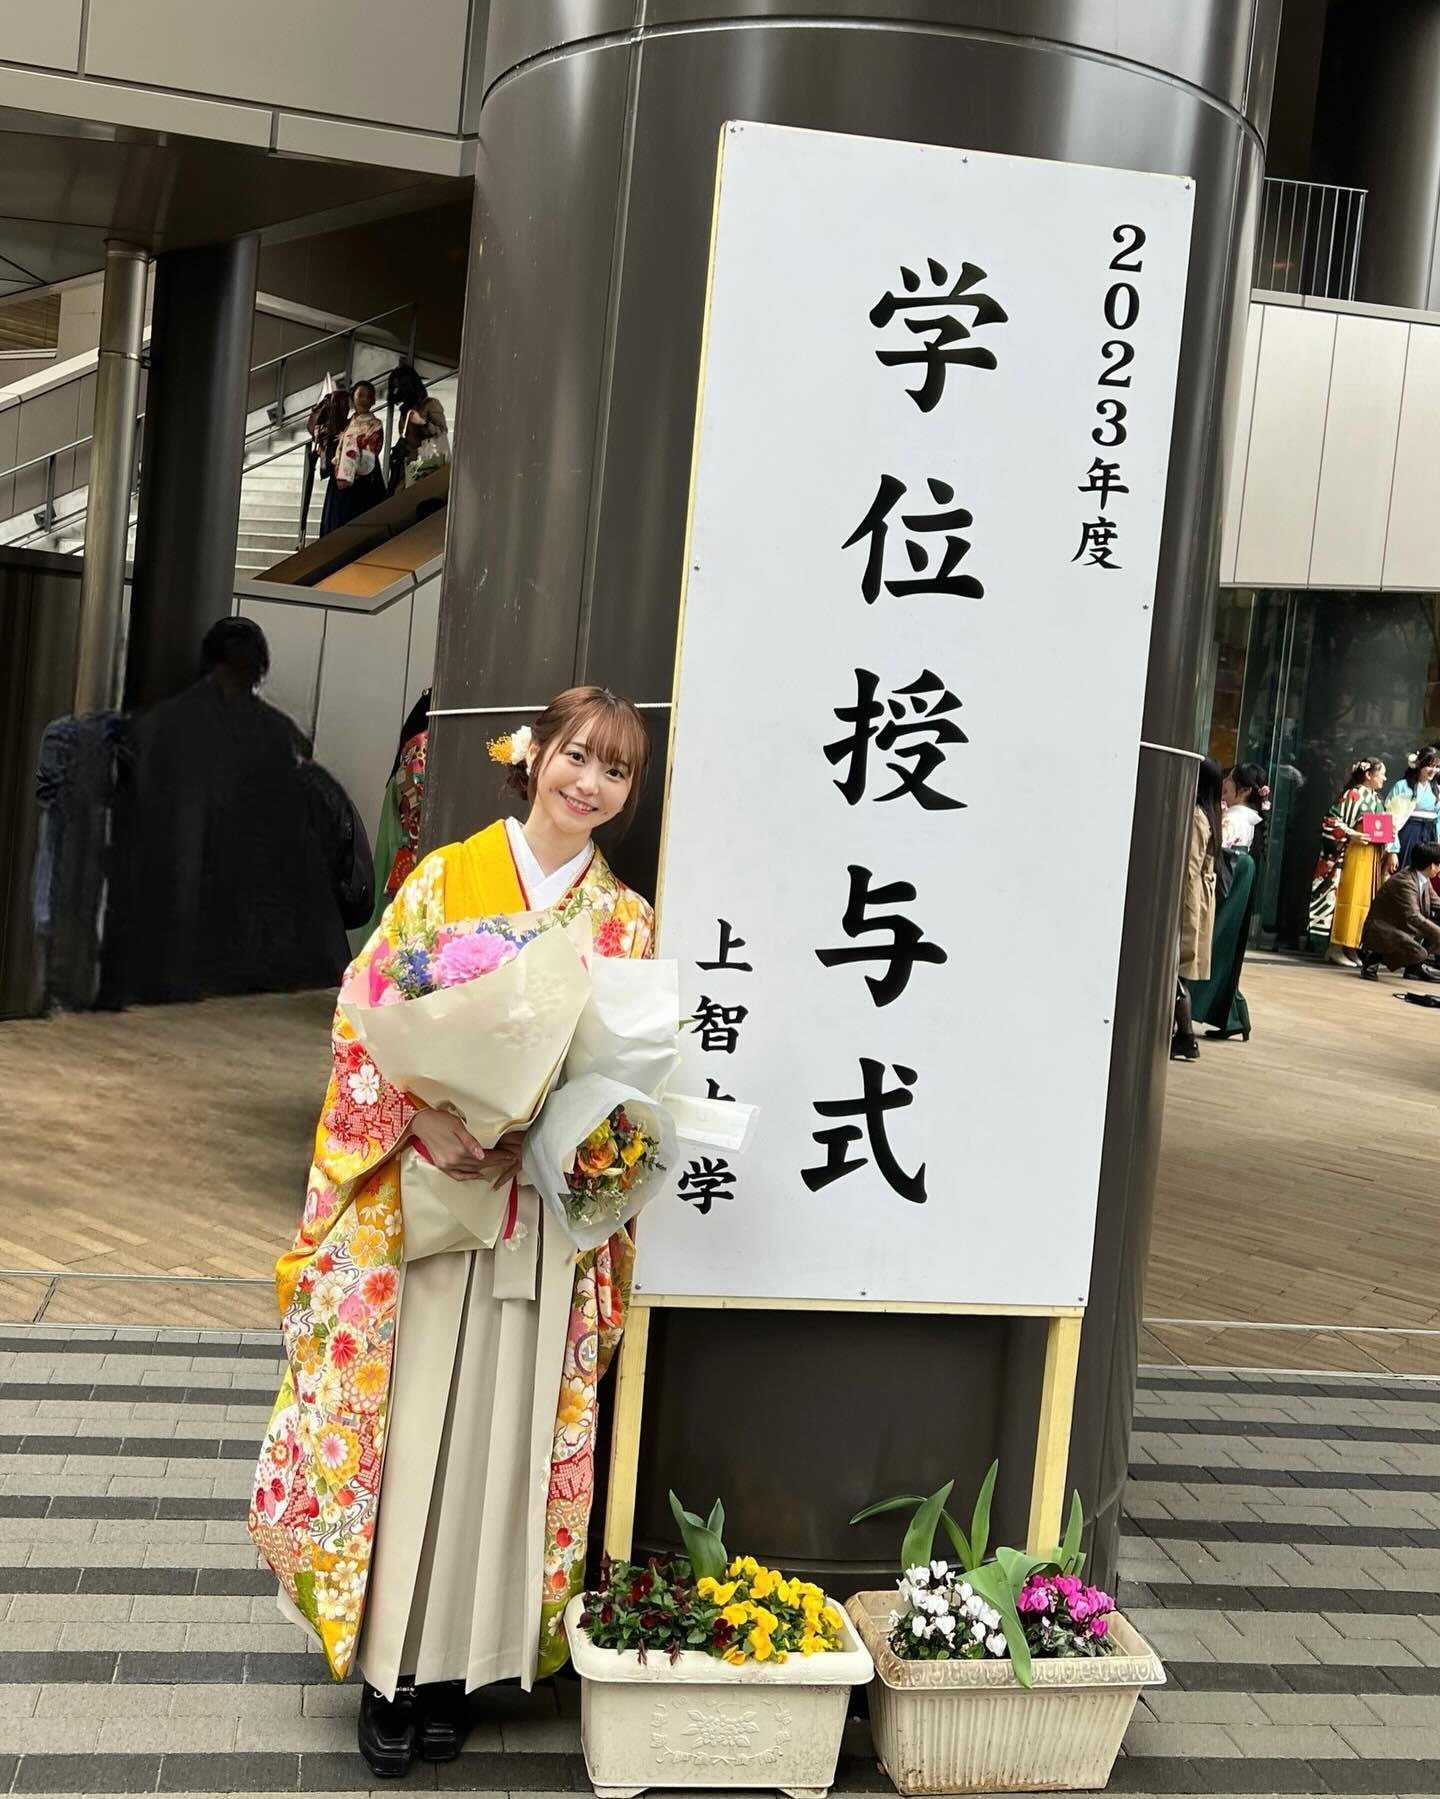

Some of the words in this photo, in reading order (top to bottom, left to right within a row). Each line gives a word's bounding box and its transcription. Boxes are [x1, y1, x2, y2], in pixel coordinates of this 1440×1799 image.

[1071, 223, 1147, 570] 2023年度
[801, 257, 1009, 1204] 学位授与式
